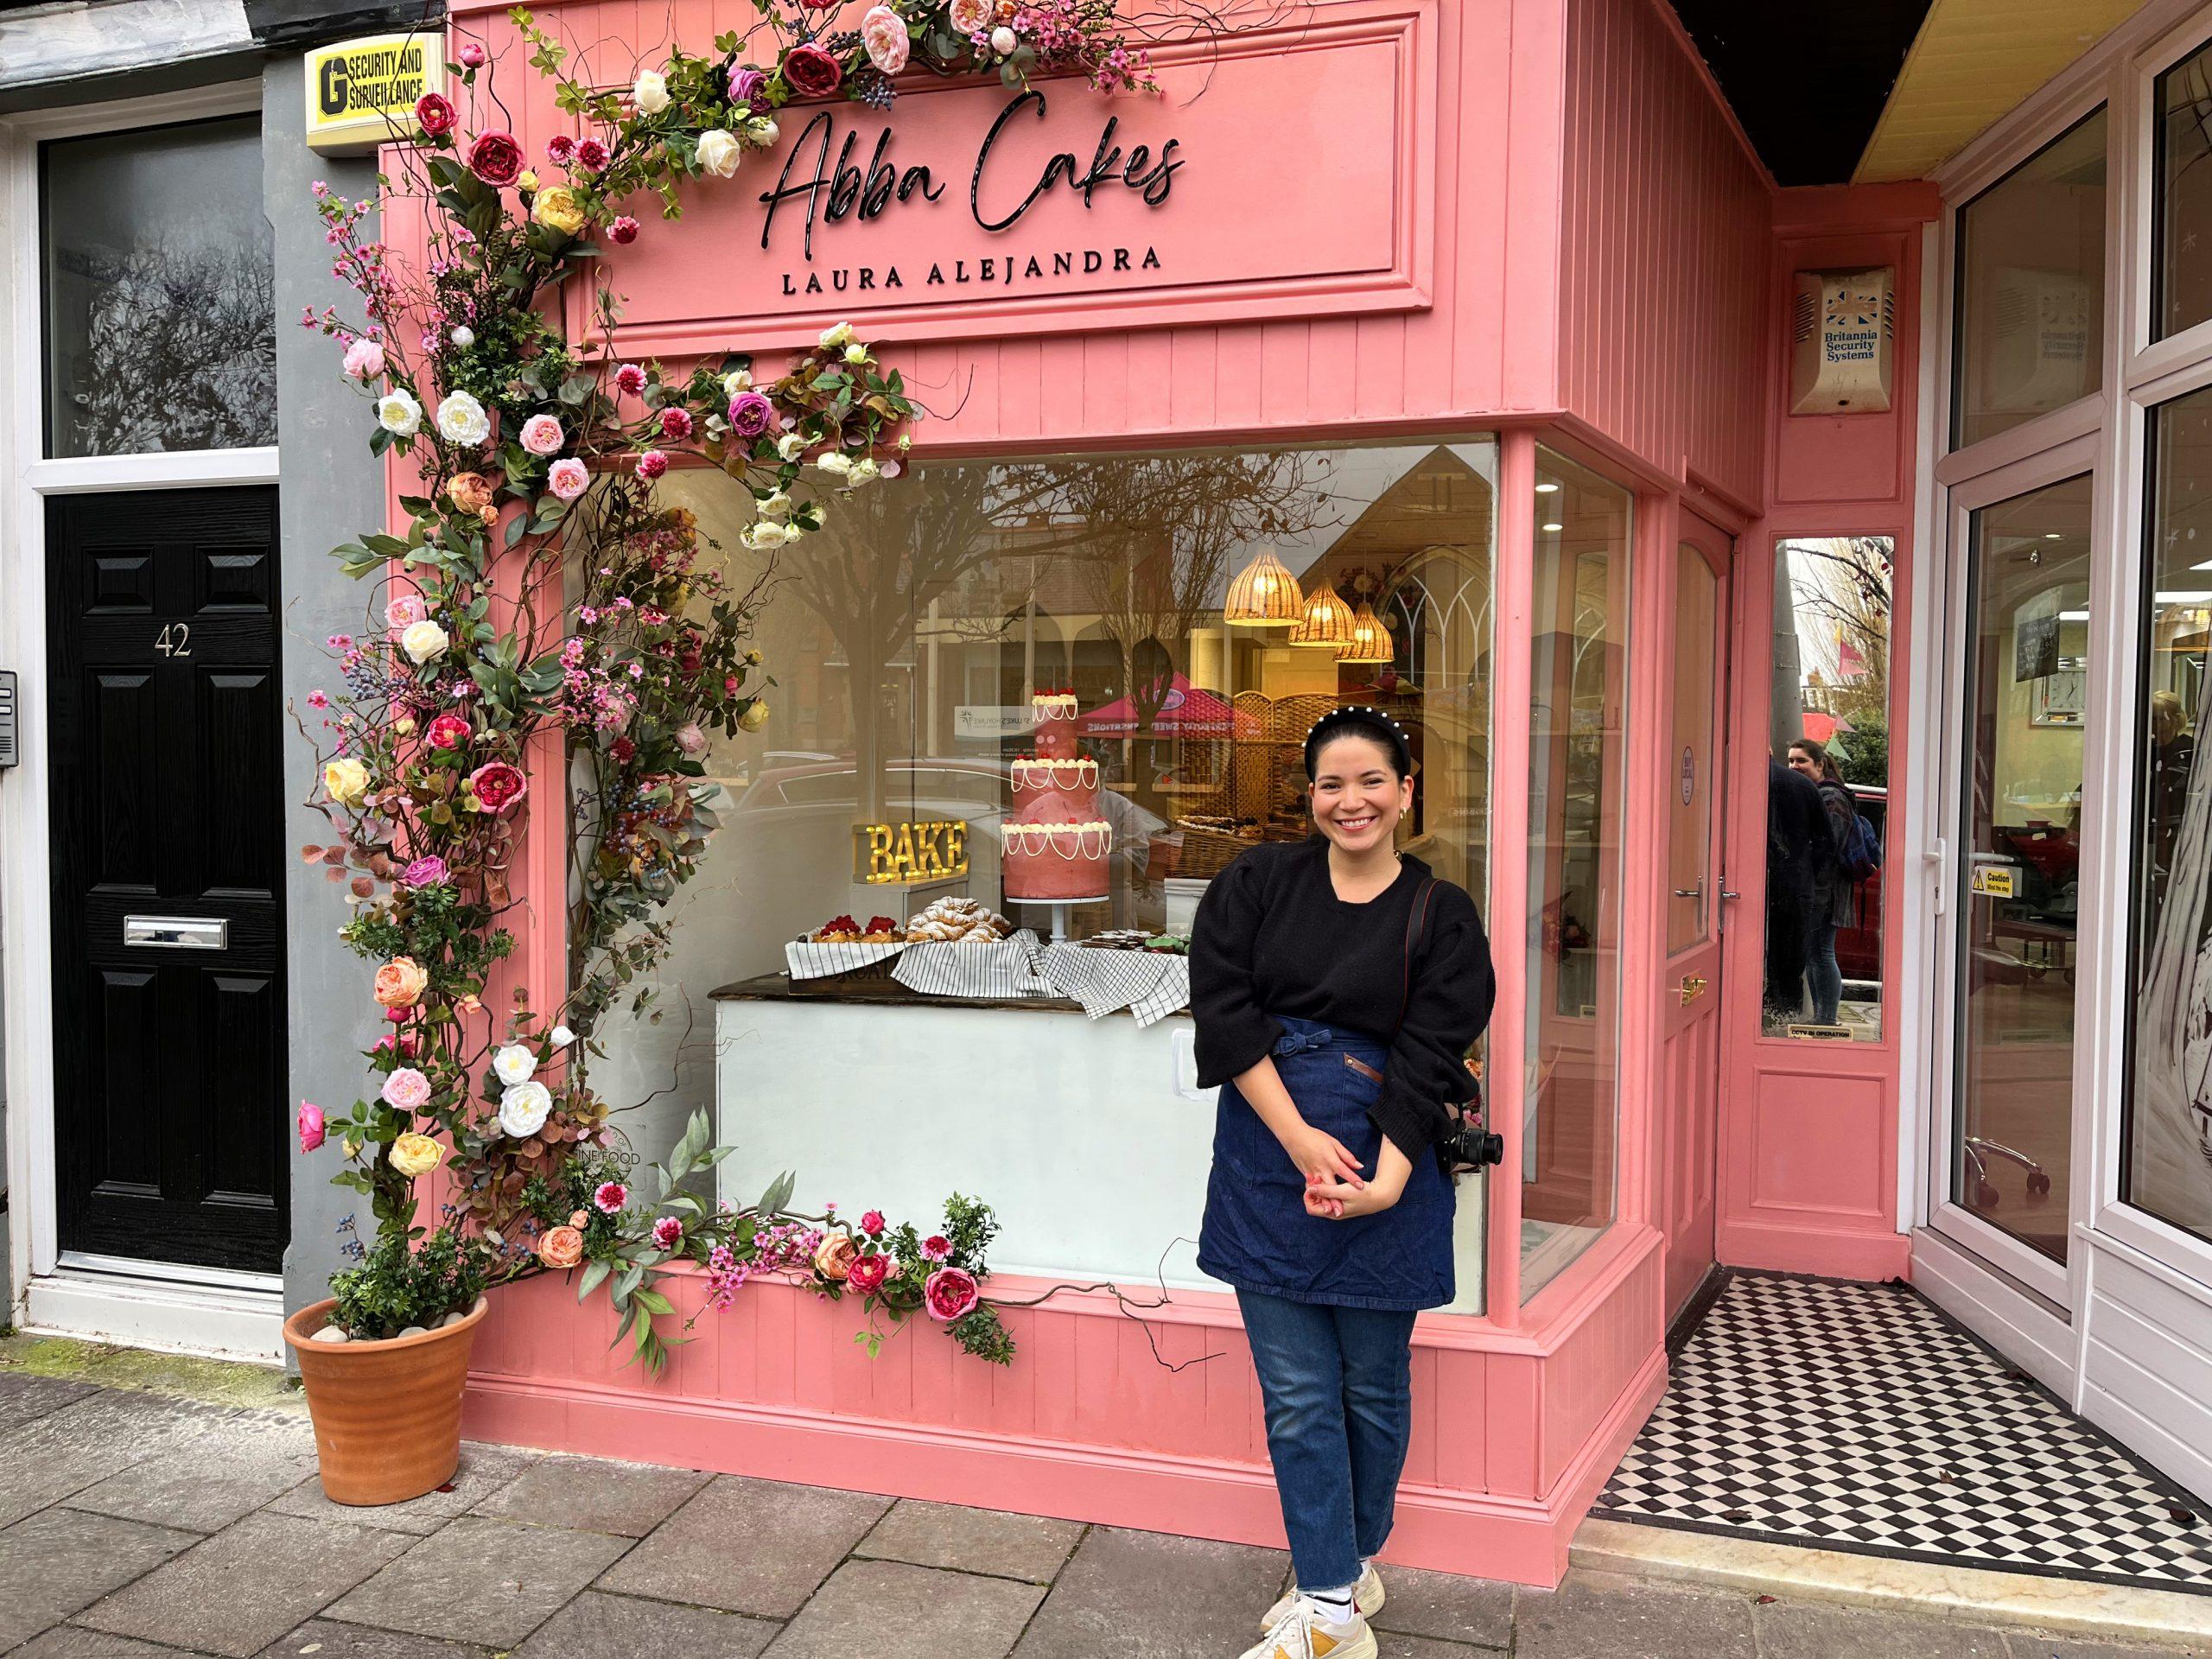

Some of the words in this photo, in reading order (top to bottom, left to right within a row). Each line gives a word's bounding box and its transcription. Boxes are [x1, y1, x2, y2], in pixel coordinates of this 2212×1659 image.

[349, 50, 397, 80] SECURITY
[400, 48, 423, 74] AND
[349, 78, 423, 111] SURVEILLANCE
[759, 111, 946, 262] Abba
[970, 90, 1185, 232] Cakes
[782, 265, 903, 296] LAURA
[926, 245, 1161, 285] ALEJANDRA
[1825, 329, 1878, 342] Britannia
[1827, 340, 1875, 352] Security
[1827, 351, 1874, 363] Systems
[155, 623, 192, 657] 42
[866, 820, 969, 884] BAKE
[1987, 872, 2010, 883] Caution
